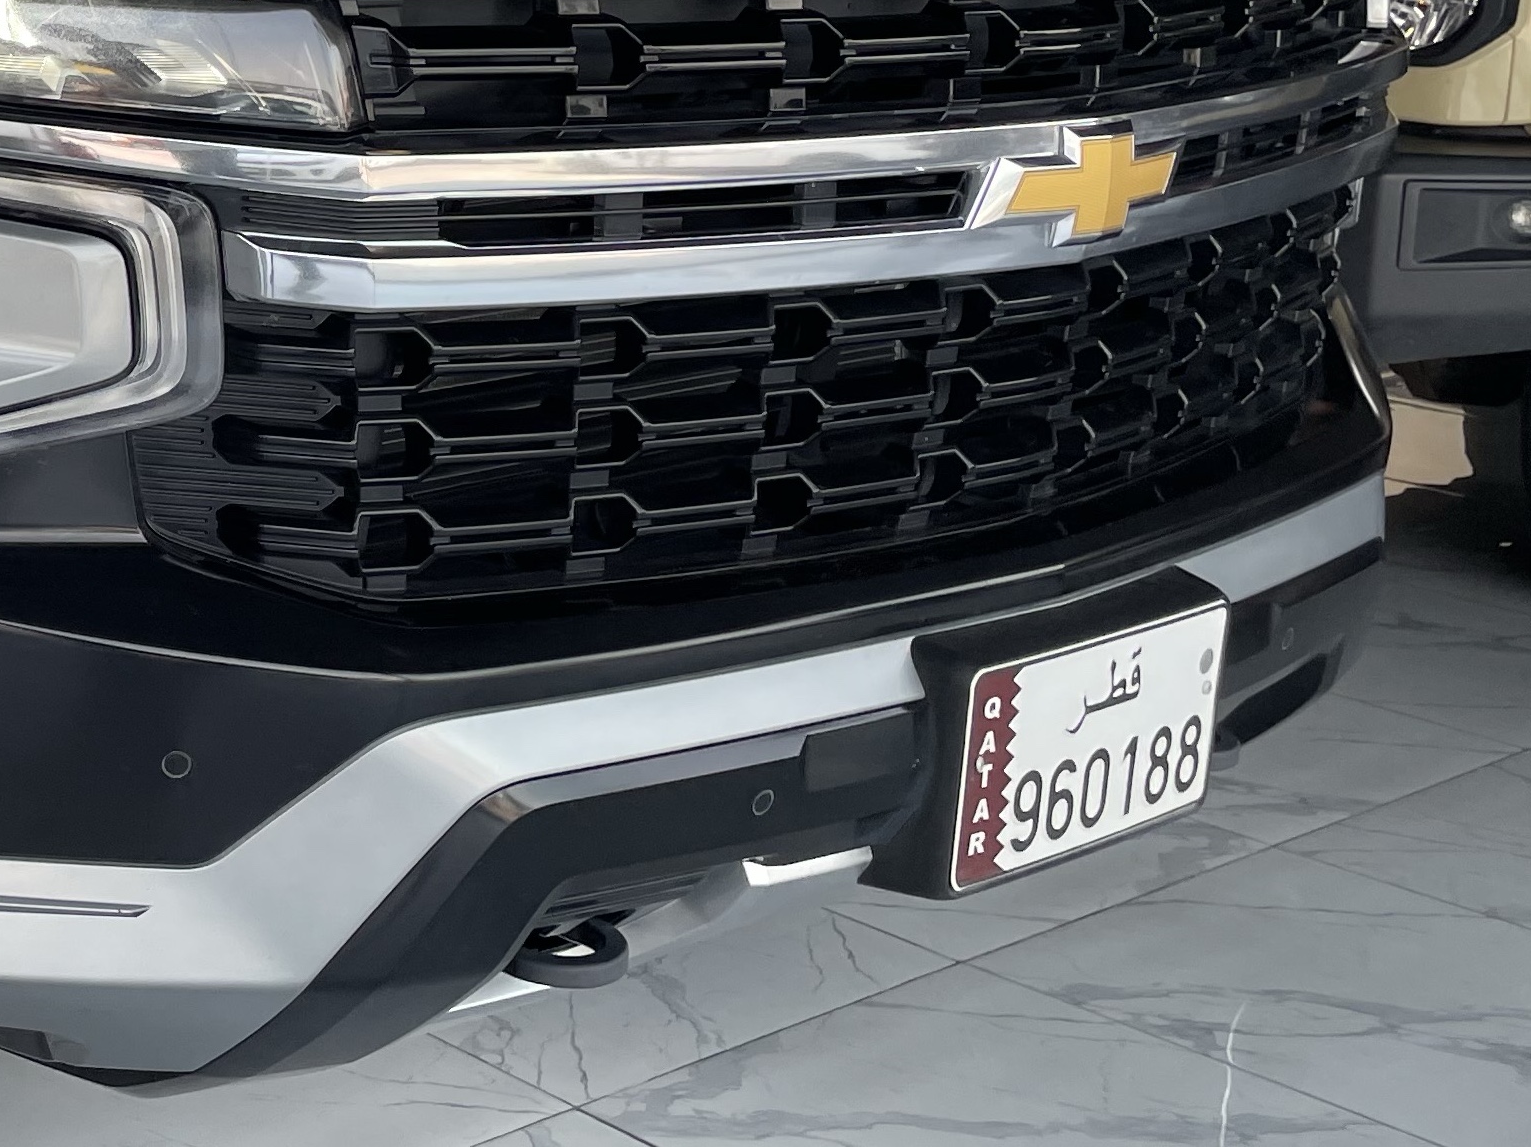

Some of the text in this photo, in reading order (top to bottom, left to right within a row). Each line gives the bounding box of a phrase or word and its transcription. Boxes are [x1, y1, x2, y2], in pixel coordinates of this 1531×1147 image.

[1065, 647, 1142, 734] قطر
[968, 696, 1002, 857] QATAR
[1010, 715, 1202, 852] 960188
